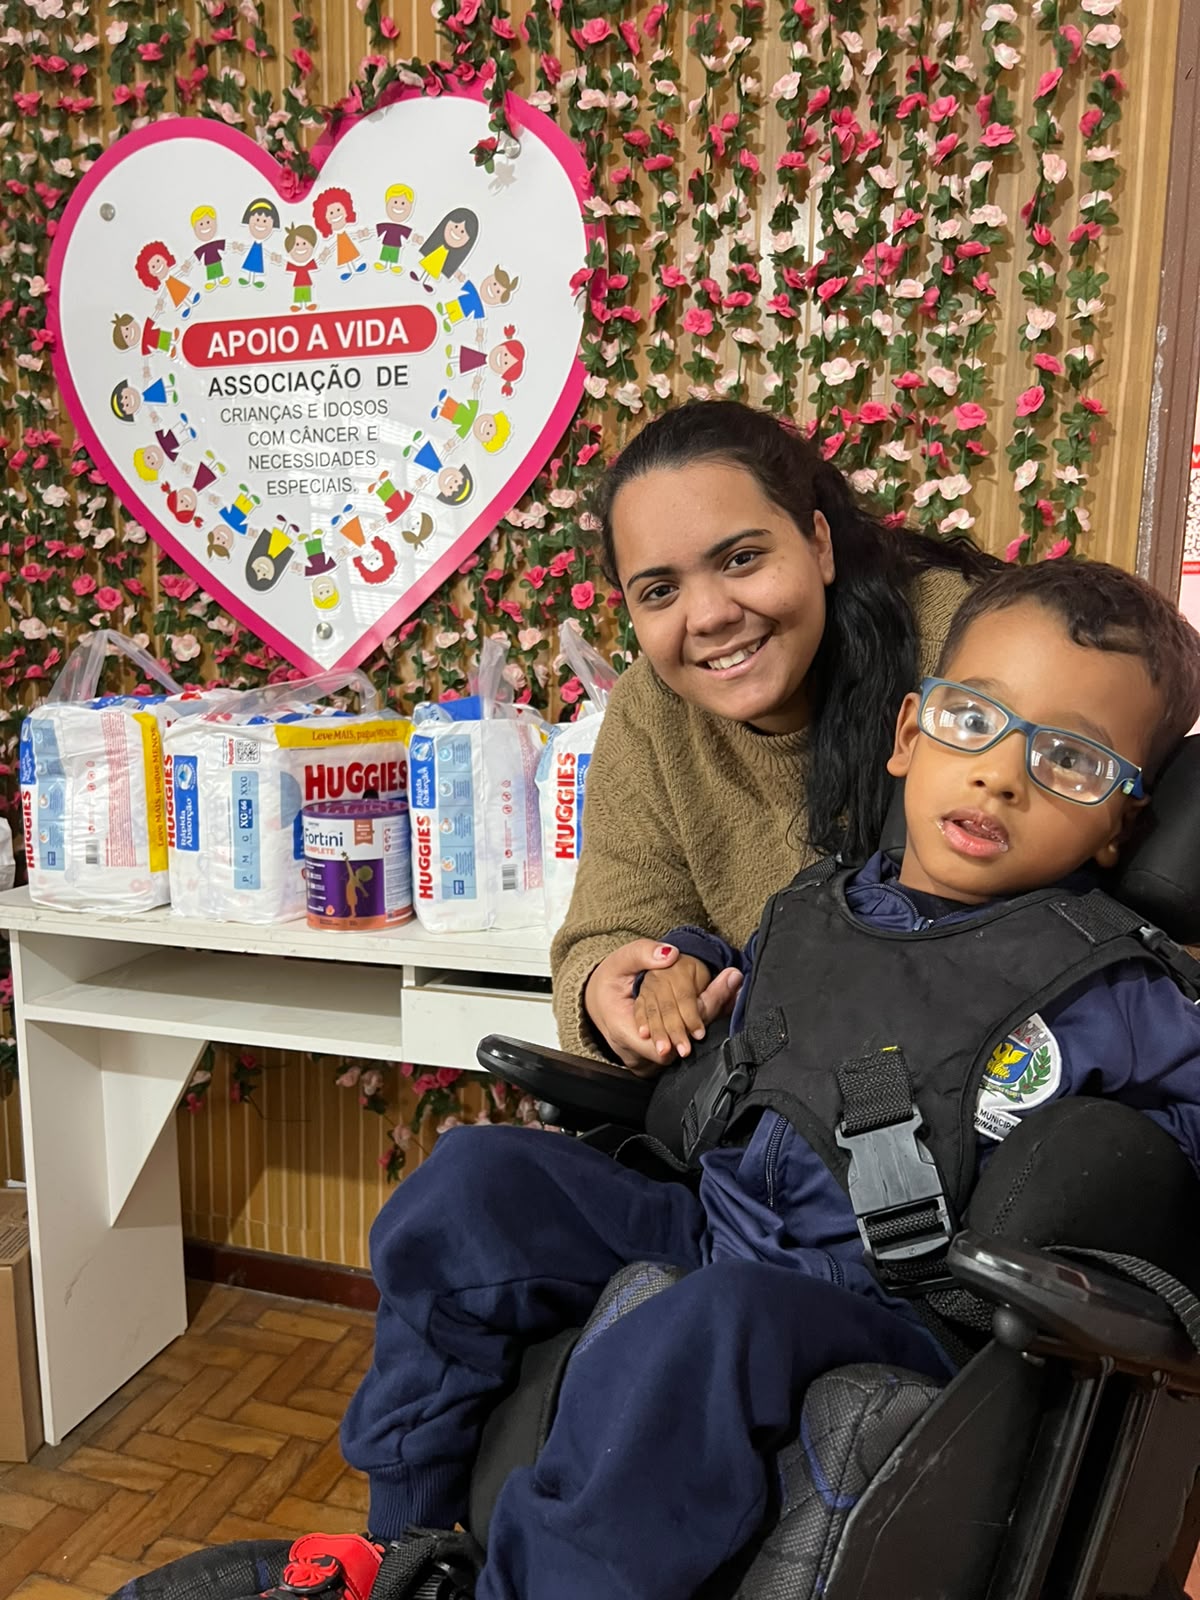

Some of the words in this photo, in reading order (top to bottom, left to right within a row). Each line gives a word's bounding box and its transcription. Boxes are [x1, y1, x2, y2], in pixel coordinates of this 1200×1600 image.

[207, 325, 300, 359] APOIO
[307, 323, 329, 352] A
[334, 316, 410, 349] VIDA
[208, 364, 361, 397] ASSOCIAÇÃO
[377, 365, 409, 387] DE
[220, 403, 303, 424] CRIANÇAS
[308, 403, 318, 417] E
[323, 399, 389, 417] IDOSOS
[248, 430, 286, 447] COM
[289, 425, 360, 445] CÂNCER
[367, 426, 378, 441] E
[248, 450, 377, 470] NECESSIDADES
[266, 478, 357, 496] ESPECIAIS.
[312, 731, 333, 741] Leve
[304, 760, 407, 801] HUGGIES
[164, 755, 175, 848] HUGGIES
[555, 752, 576, 859] HUGGIES
[157, 824, 165, 848] Leve
[179, 810, 187, 846] Rápida
[185, 798, 194, 848] Absorção
[416, 815, 434, 899] HUGGIES
[973, 1116, 998, 1133] PINAS
